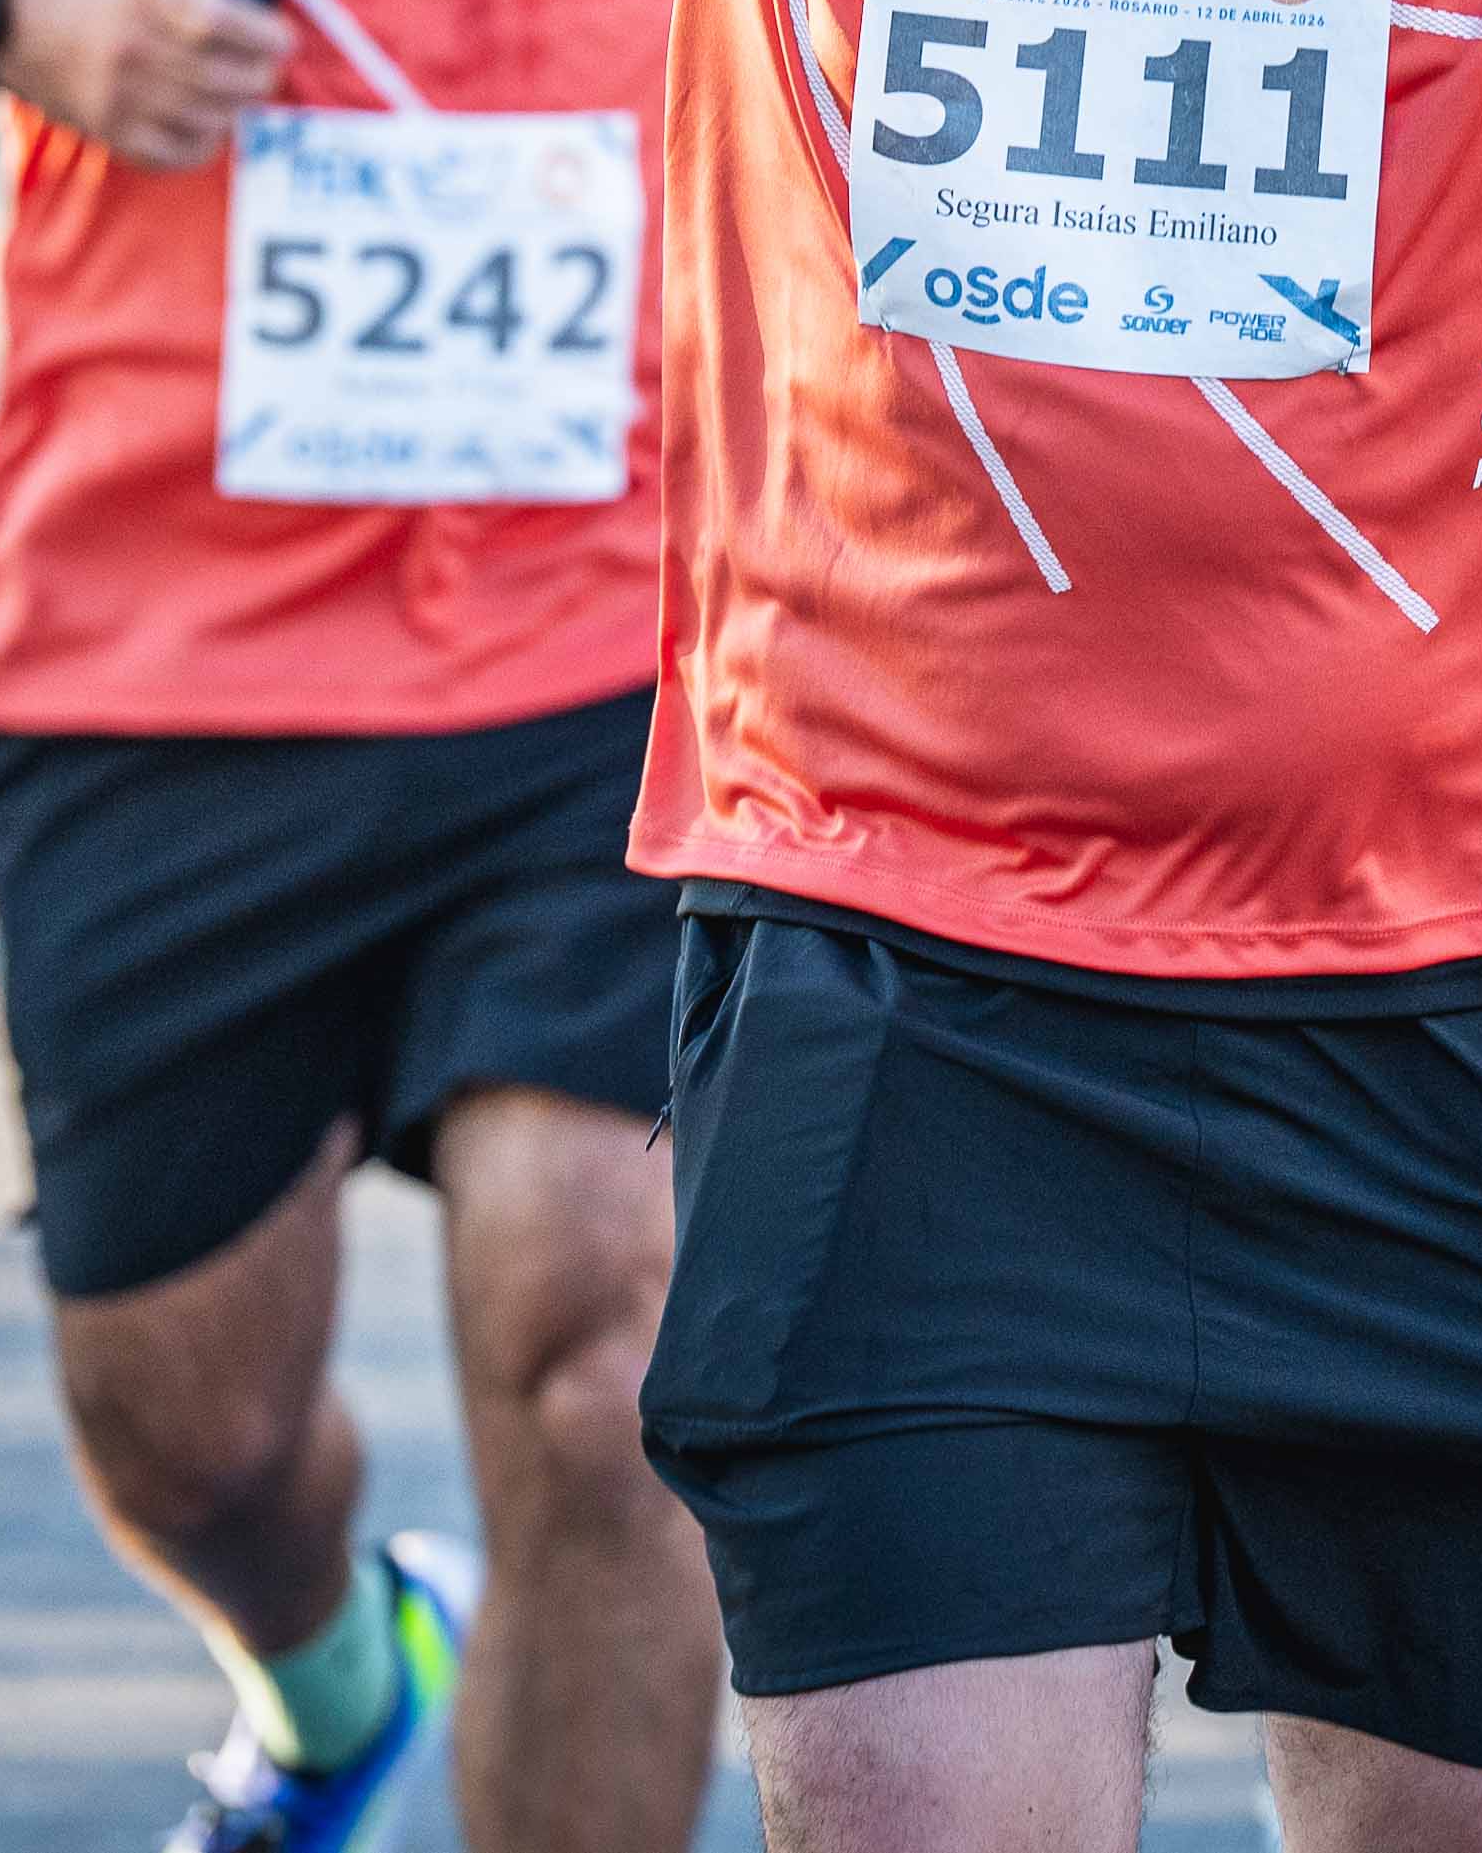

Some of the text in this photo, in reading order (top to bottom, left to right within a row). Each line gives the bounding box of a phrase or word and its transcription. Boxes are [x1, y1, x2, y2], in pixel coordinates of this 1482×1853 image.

[1109, 0, 1178, 17] ROSARIO
[1197, 7, 1213, 20] 12
[1219, 8, 1237, 22] DE
[1242, 9, 1284, 25] ABRIL
[1290, 13, 1326, 27] 2026
[872, 10, 1348, 200] 5111
[935, 187, 1278, 246] Segura Isaías Emiliano
[252, 235, 614, 356] 5242
[1209, 309, 1286, 329] POWER
